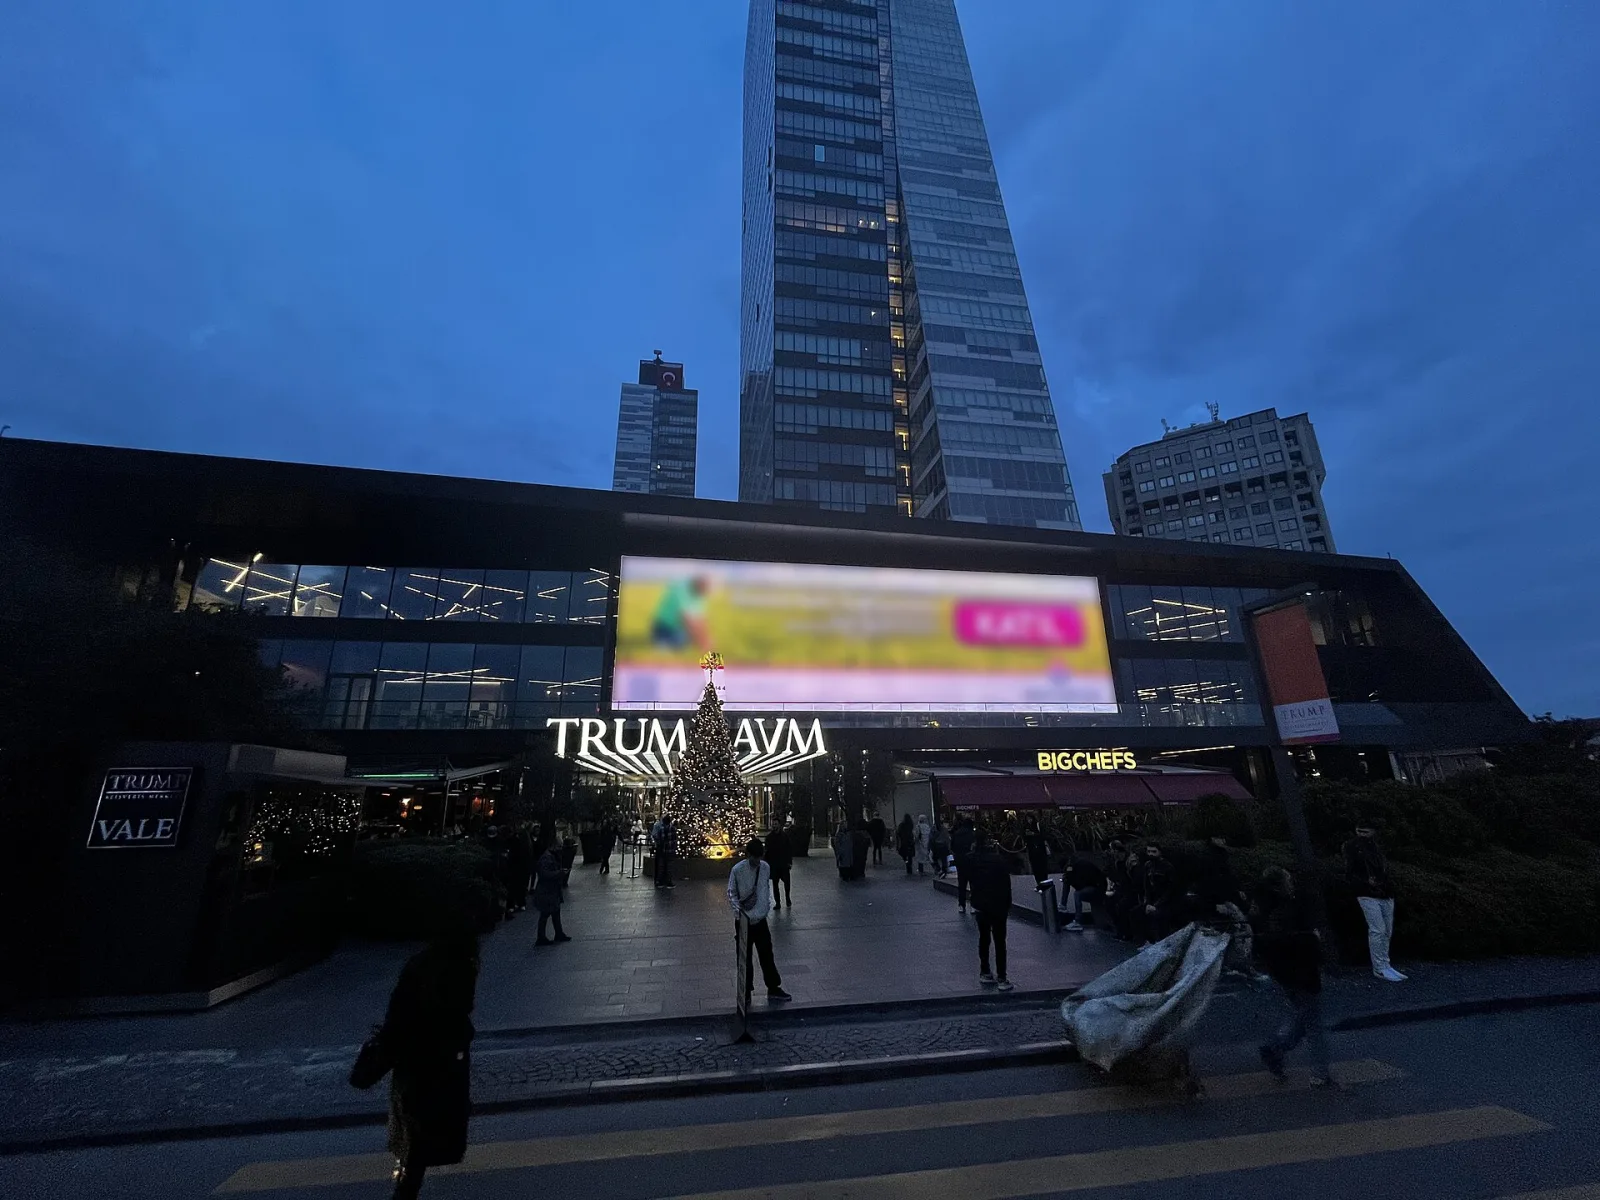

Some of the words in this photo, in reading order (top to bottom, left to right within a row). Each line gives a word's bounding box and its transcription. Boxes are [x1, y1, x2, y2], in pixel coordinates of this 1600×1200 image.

[1281, 705, 1325, 720] TRUMP
[546, 717, 688, 758] TRUM
[734, 717, 828, 755] AVM
[1037, 751, 1137, 771] BIGCHEFS
[109, 774, 187, 790] TRUMP
[98, 818, 175, 841] VALE
